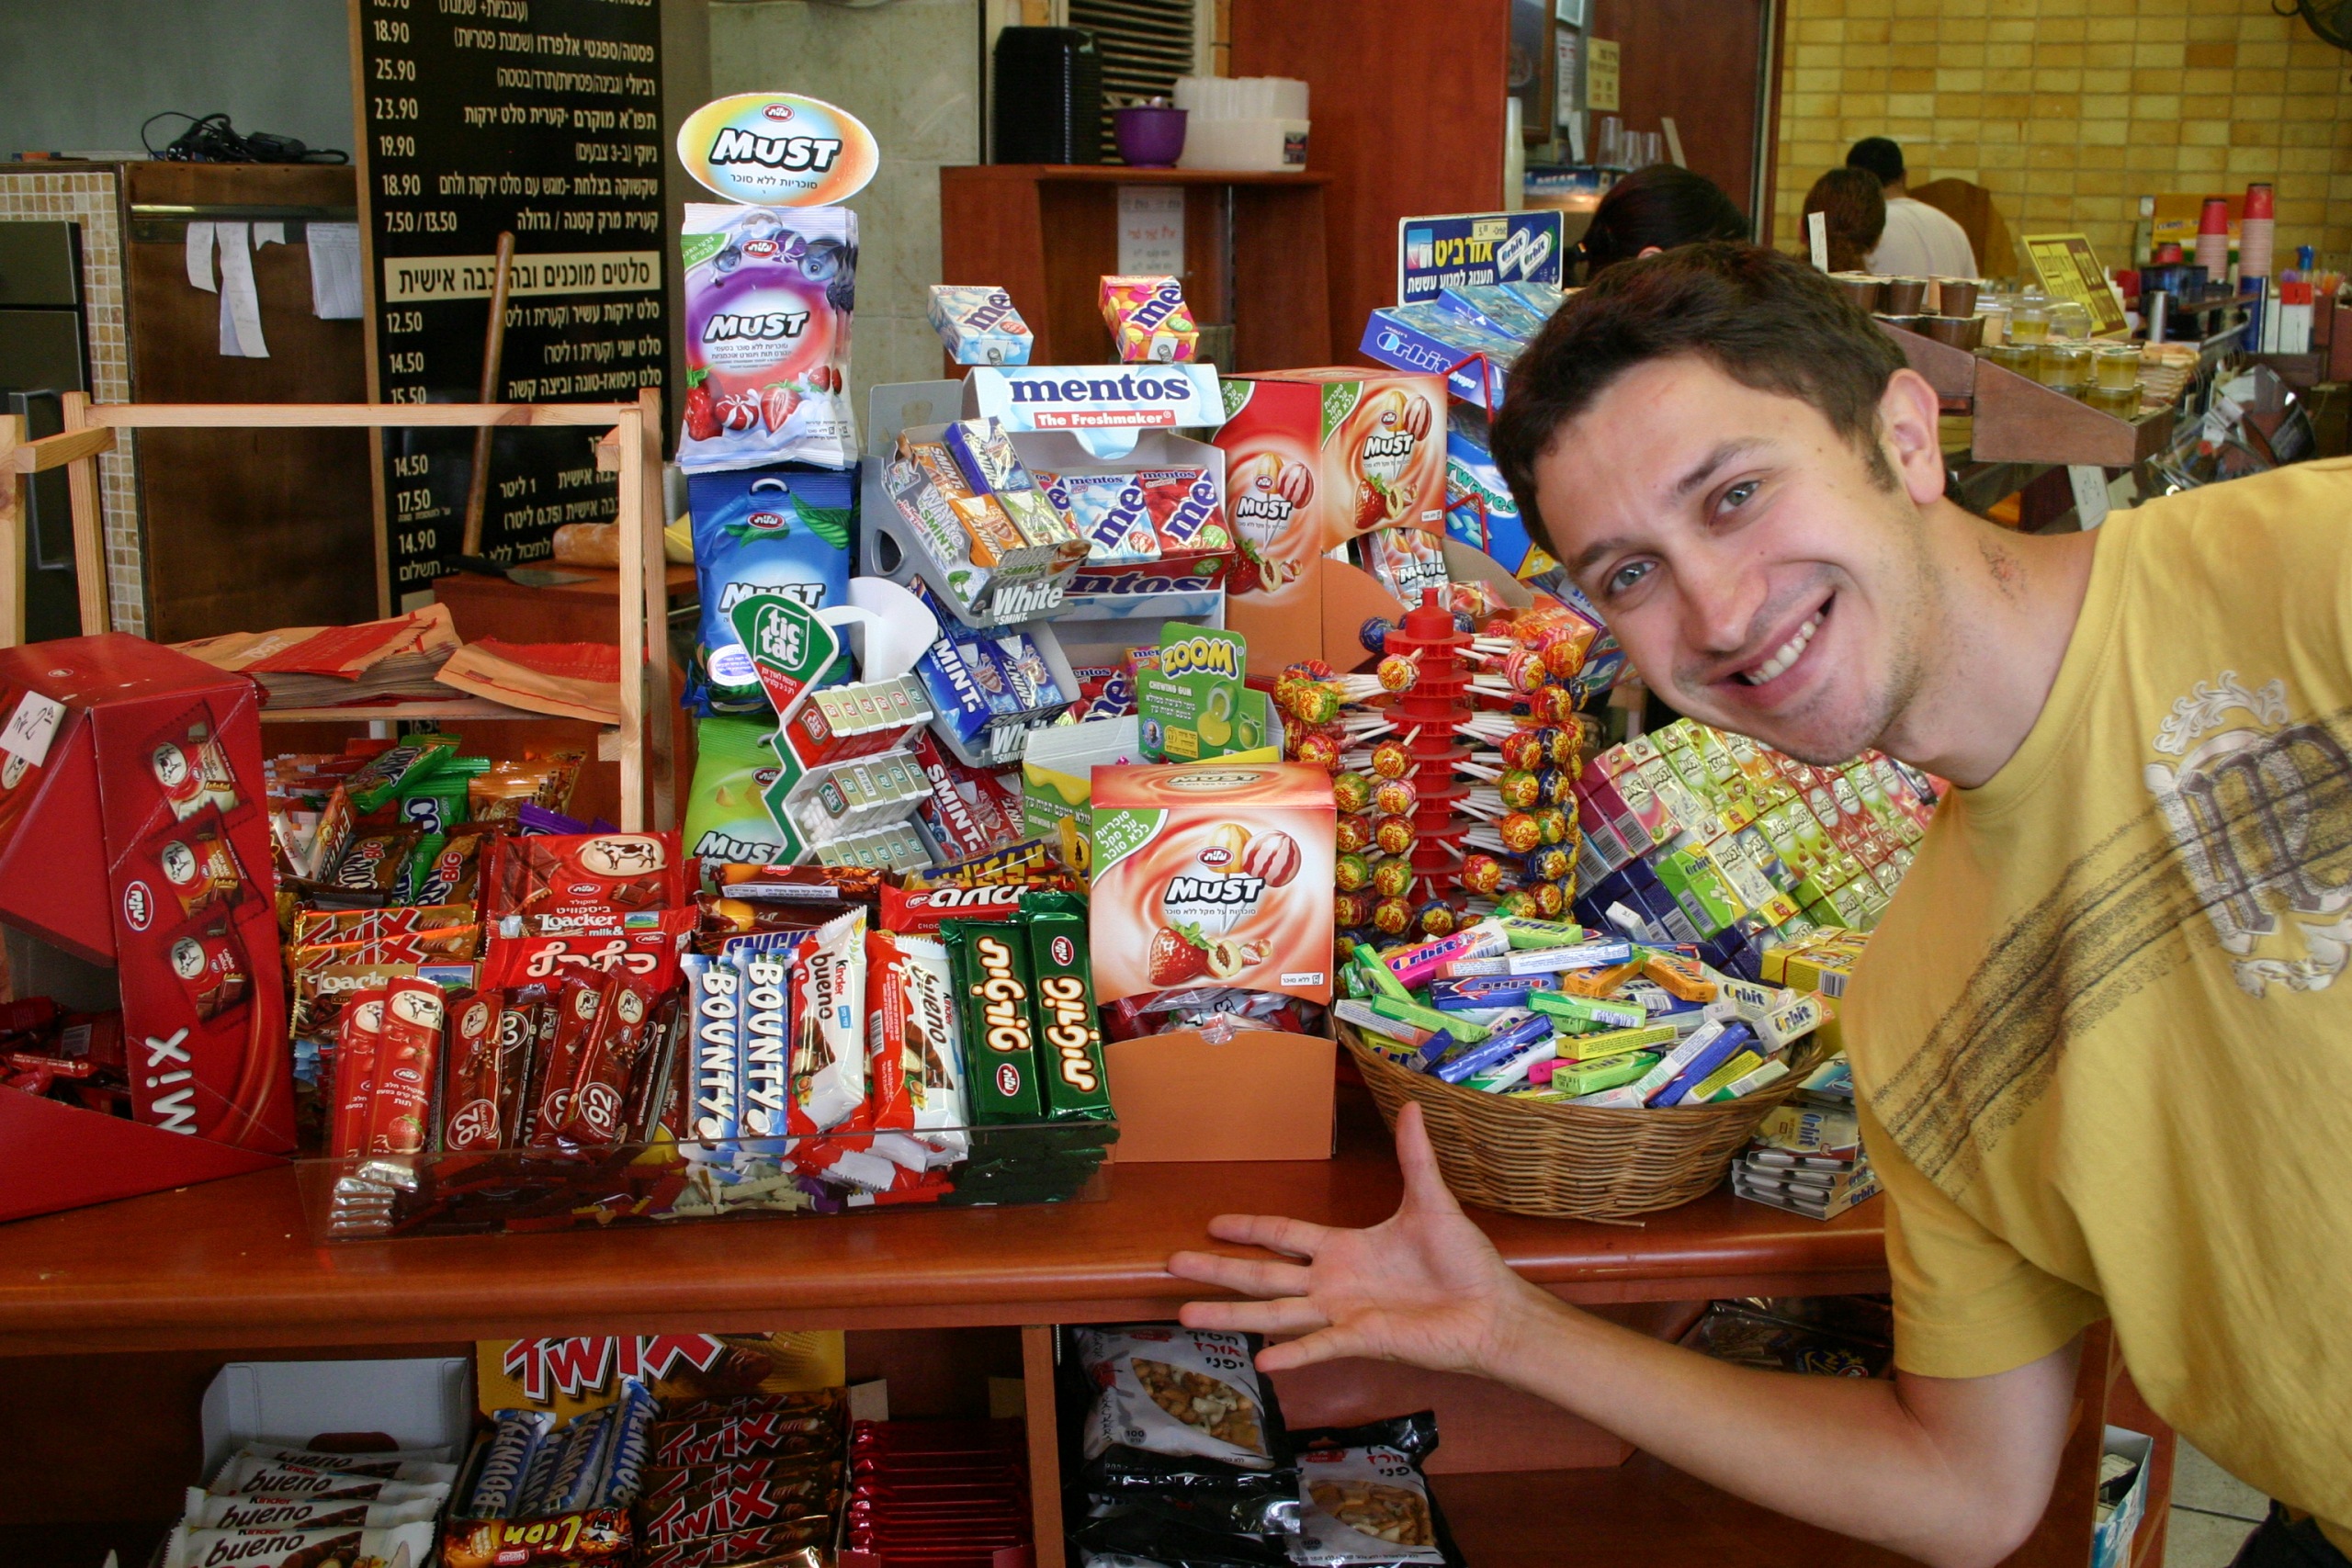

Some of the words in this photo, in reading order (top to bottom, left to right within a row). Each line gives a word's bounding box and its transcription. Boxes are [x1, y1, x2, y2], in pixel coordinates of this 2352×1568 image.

[374, 20, 410, 43] 18.90
[537, 32, 580, 56] אלפרדו
[376, 58, 416, 82] 25.90
[375, 97, 418, 120] 23.90
[464, 105, 497, 129] ירקות
[501, 103, 526, 124] סלט
[573, 110, 615, 133] מוקרם
[379, 136, 415, 157] 19.90
[634, 144, 657, 167] ניוקי
[709, 128, 842, 172] MUST
[382, 175, 421, 197] 18.90
[469, 175, 497, 199] ירקות
[500, 172, 522, 196] סלט
[525, 175, 540, 196] עם
[573, 172, 611, 196] בצלחת
[615, 177, 658, 201] שקשוקה
[730, 174, 753, 185] סוכר
[757, 175, 776, 186] ללא
[780, 179, 818, 190] סוכריות
[385, 211, 413, 233] 7.50
[425, 210, 457, 232] 13.50
[516, 208, 550, 231] גדולה
[564, 211, 594, 235] קטנה
[598, 211, 621, 235] מרק
[626, 211, 659, 235] קערית
[1434, 236, 1495, 267] אורביט
[1501, 236, 1525, 263] Orbit
[1523, 240, 1546, 267] Orbit
[399, 267, 456, 295] אישית
[544, 262, 595, 288] מוכנים
[602, 257, 650, 285] סלטים
[1468, 269, 1494, 286] תענוג
[1407, 275, 1437, 294] עששת
[387, 311, 423, 333] 12.50
[703, 310, 810, 344] MUST
[639, 334, 662, 356] סלט
[1376, 332, 1453, 375] Orbit
[390, 352, 424, 374] 14.50
[540, 377, 572, 397] וביצה
[639, 367, 662, 388] סלט
[1010, 374, 1191, 403] mentos
[1448, 371, 1477, 389] drops
[508, 379, 537, 403] קשה
[1037, 413, 1067, 427] The
[1071, 412, 1162, 427] Freshmaker
[1363, 434, 1414, 458] MUST
[394, 455, 428, 478] 14.50
[1142, 470, 1197, 479] mentos
[500, 476, 527, 499] ליטר
[559, 469, 593, 490] אישית
[1069, 475, 1125, 485] mentos
[397, 489, 432, 513] 17.50
[566, 499, 597, 521] אישית
[1165, 482, 1219, 544] me
[1237, 497, 1292, 520] MUST
[1091, 487, 1147, 550] me
[399, 529, 436, 555] 14.90
[993, 583, 1063, 616] White
[768, 609, 800, 645] tic
[761, 627, 800, 667] tac
[1162, 637, 1238, 680] ZOOM
[1646, 764, 1672, 789] MUST
[1621, 778, 1646, 802] MUST
[927, 764, 982, 852] SMINT
[1787, 808, 1812, 829] MUST
[1095, 810, 1130, 840] סוכריות
[1121, 818, 1138, 833] על
[1128, 824, 1150, 844] ללא
[361, 840, 385, 860] BIG
[1100, 830, 1123, 850] מקל
[1102, 841, 1128, 862] סוכר
[439, 852, 464, 883] BIG
[1203, 851, 1227, 862] עלית
[1684, 855, 1712, 875] Orbit
[1715, 844, 1741, 868] MUST
[1164, 877, 1265, 904] MUST
[555, 905, 612, 915] ביסקוויט
[1837, 895, 1860, 918] MUST
[535, 914, 617, 931] Loacker
[1392, 940, 1458, 971] Orbit
[810, 951, 835, 1021] bueno
[833, 959, 850, 996] Kinder
[1477, 979, 1551, 988] Orbit
[910, 964, 948, 1044] bueno
[970, 935, 1032, 1052] טורטית
[1723, 982, 1766, 1007] Orbit
[942, 992, 953, 1029] Kinder
[1773, 1005, 1813, 1033] Orbit
[698, 961, 738, 1123] BOUNTY
[746, 961, 785, 1112] BOUNTY
[1042, 976, 1101, 1092] טורטית
[145, 1025, 198, 1135] Mix
[393, 1097, 413, 1108] תות
[587, 1089, 612, 1127] 92
[457, 1106, 480, 1144] 92
[1797, 1111, 1823, 1147] Orbit
[1849, 1183, 1875, 1205] Orbit
[1193, 1342, 1243, 1358] אורז
[1204, 1356, 1245, 1371] יפני
[657, 1412, 783, 1467] Twix
[1125, 1429, 1145, 1438] 100
[472, 1416, 530, 1509] BOUNTY
[242, 1470, 332, 1494] bueno
[249, 1496, 293, 1506] Kinder
[647, 1480, 779, 1546] Twix
[216, 1505, 313, 1529] bueno
[503, 1516, 582, 1552] Lion
[203, 1534, 305, 1567] bueno
